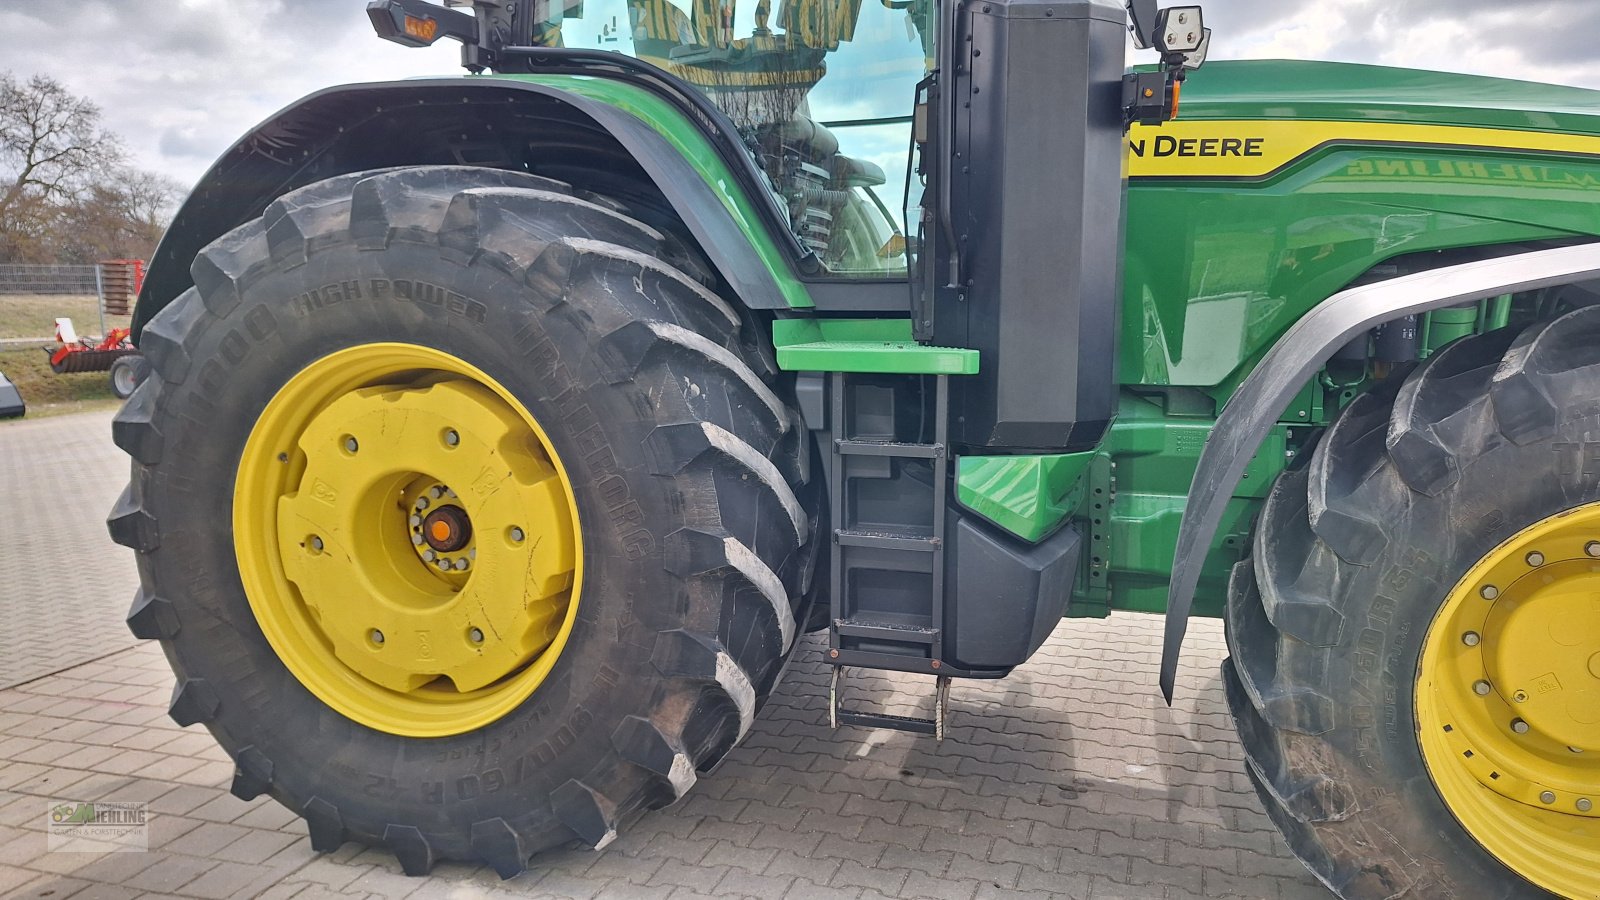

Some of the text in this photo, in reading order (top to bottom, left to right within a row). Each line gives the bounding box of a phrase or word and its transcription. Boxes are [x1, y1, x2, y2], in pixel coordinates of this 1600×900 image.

[1153, 135, 1264, 157] DEERE
[291, 279, 362, 317] HIGH
[369, 278, 489, 324] POWER
